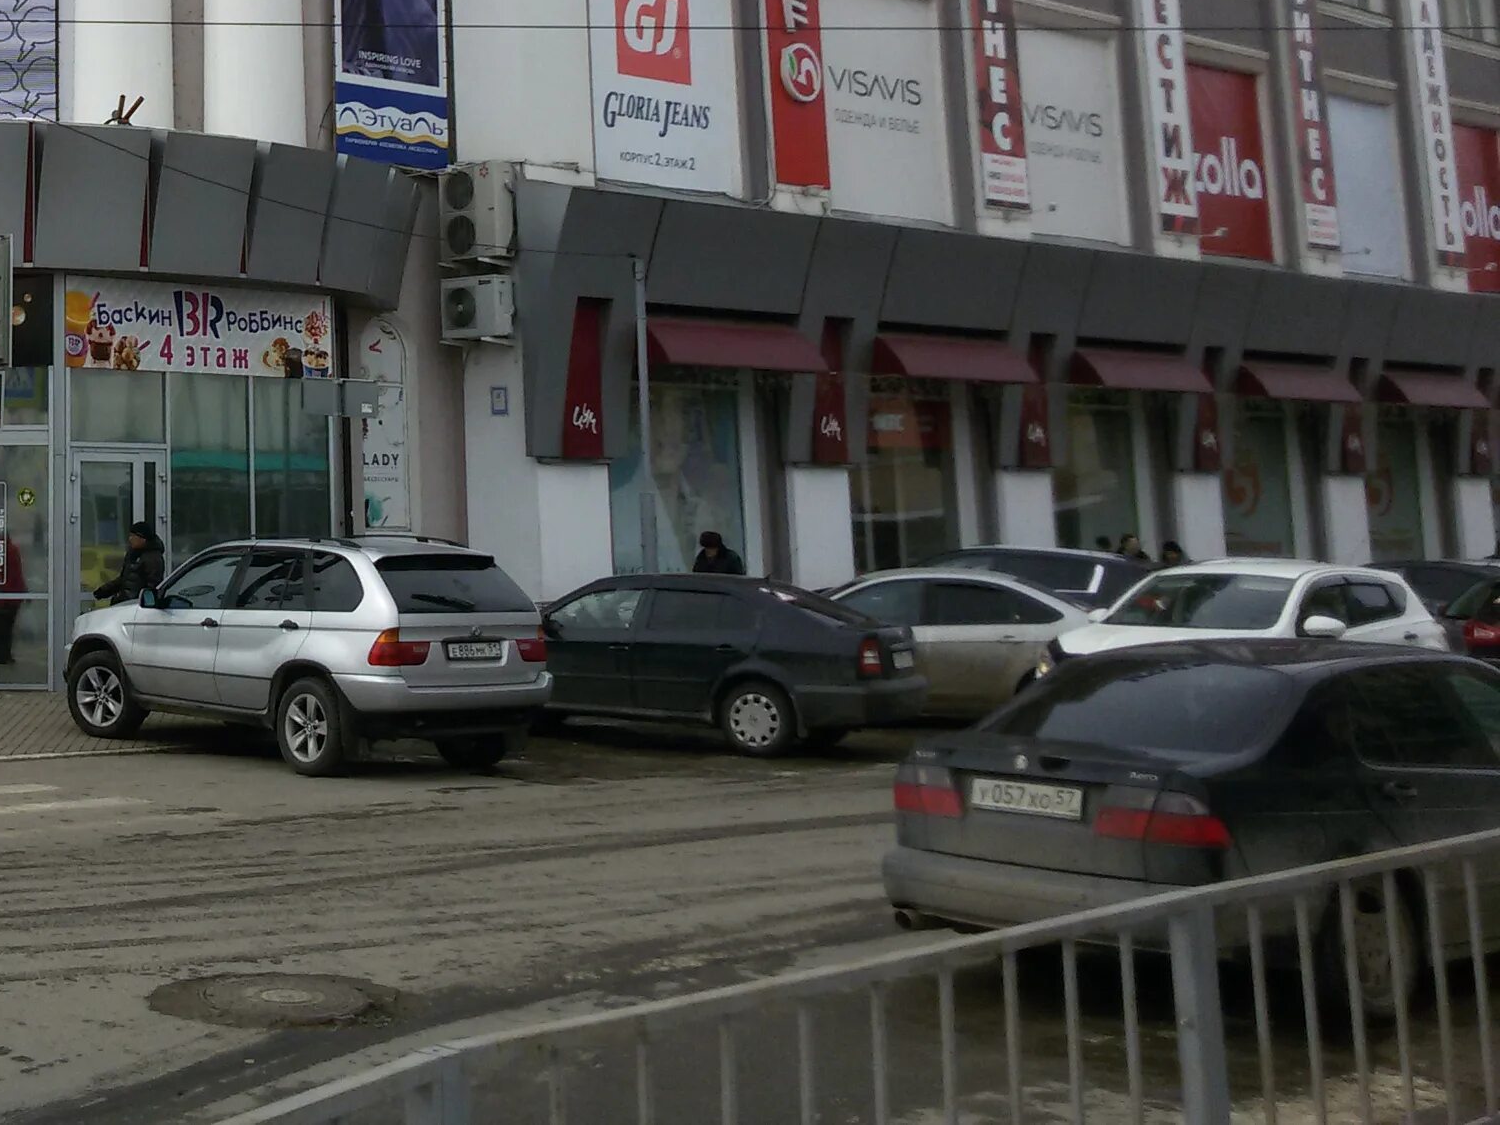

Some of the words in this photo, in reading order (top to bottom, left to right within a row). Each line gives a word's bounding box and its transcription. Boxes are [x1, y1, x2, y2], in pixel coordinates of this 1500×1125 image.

[358, 50, 399, 65] INSPIRING
[400, 56, 422, 68] LOVE
[828, 65, 922, 106] VISAVIS
[603, 91, 661, 128] GLORIA
[658, 100, 710, 137] JEANS
[1022, 102, 1103, 138] VISAVIS
[620, 151, 654, 165] КОРПУС
[688, 157, 696, 171] 2
[159, 334, 174, 365] 4
[185, 346, 249, 369] этаж
[362, 453, 399, 466] LADY
